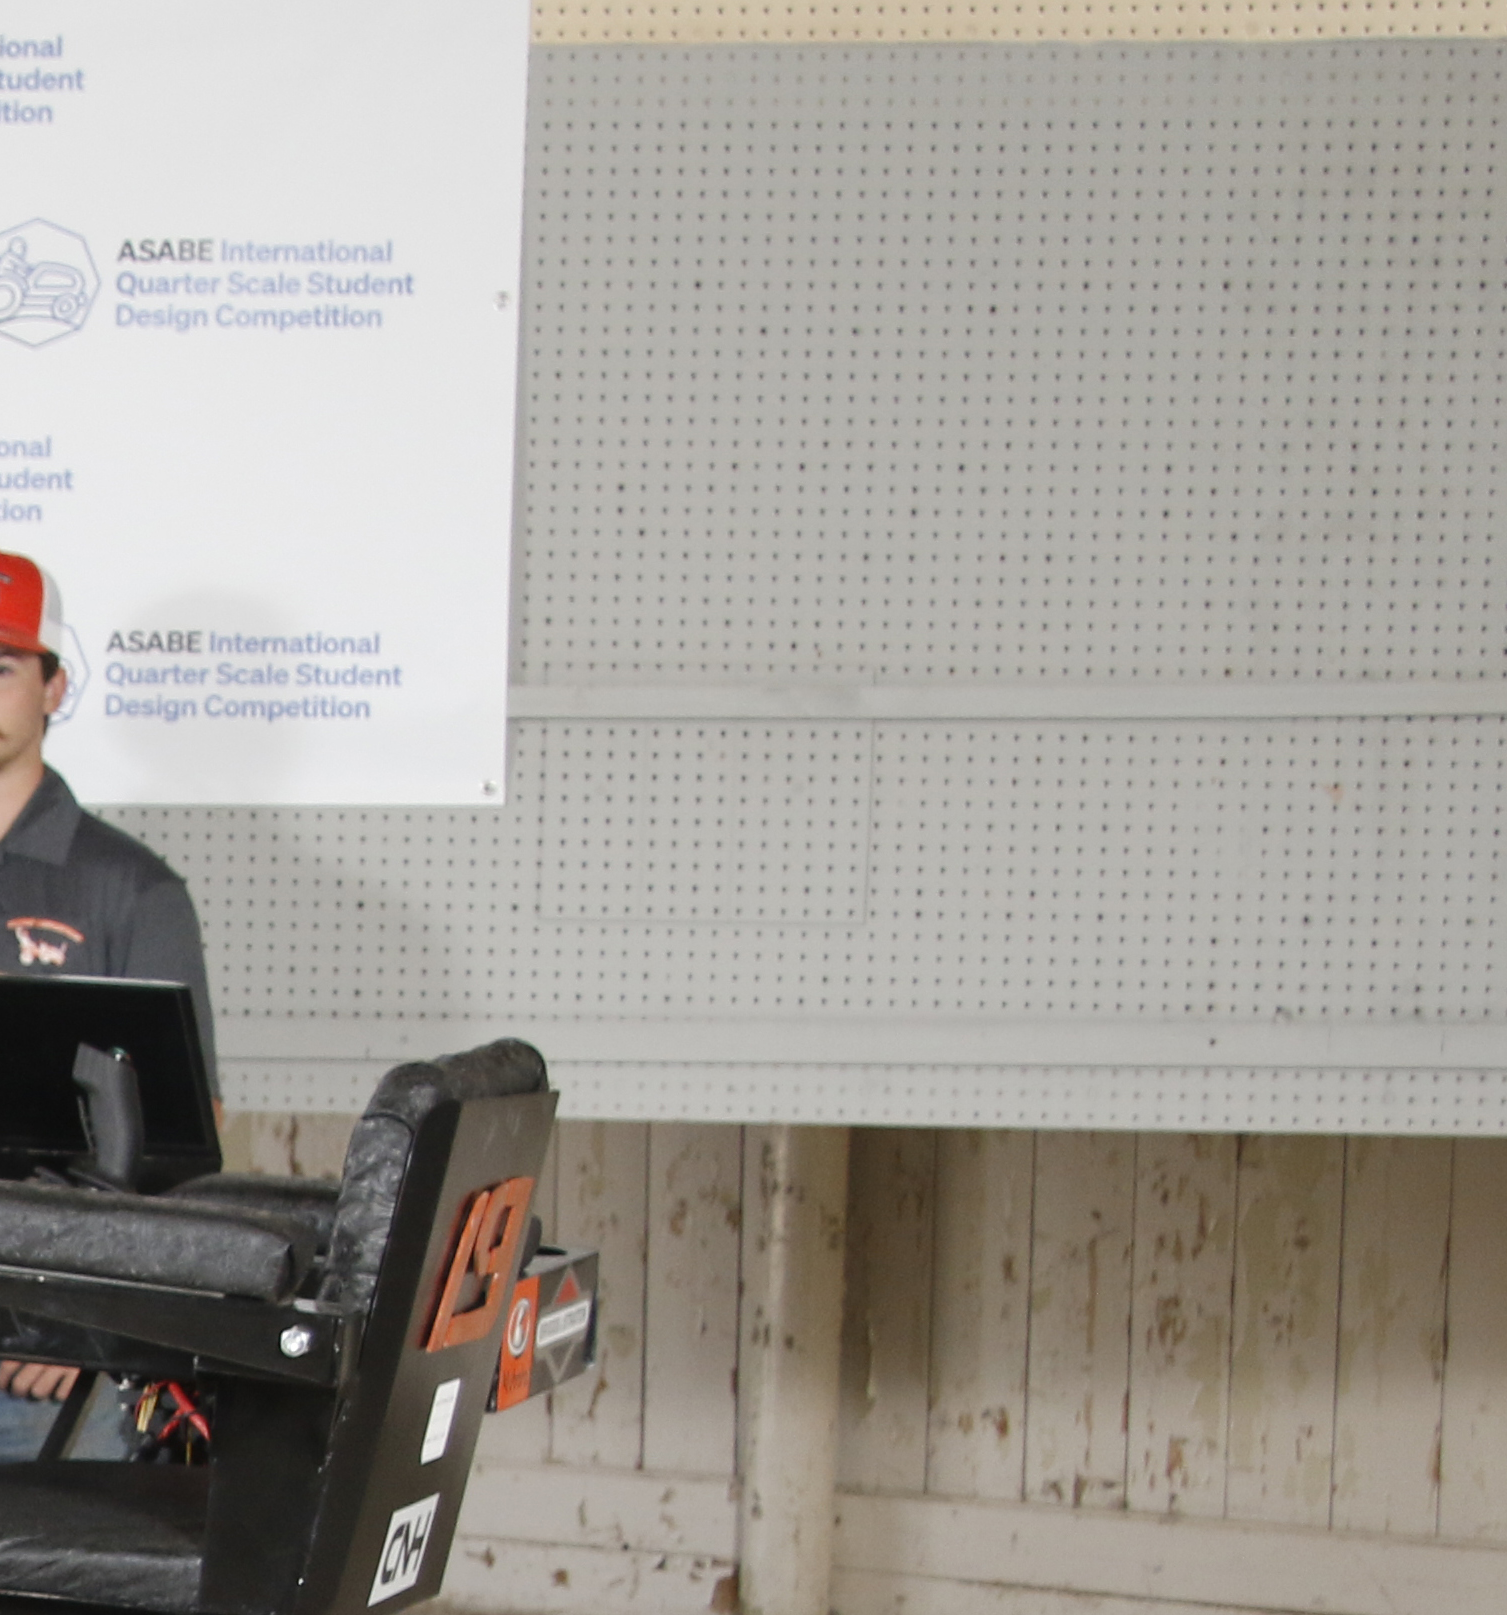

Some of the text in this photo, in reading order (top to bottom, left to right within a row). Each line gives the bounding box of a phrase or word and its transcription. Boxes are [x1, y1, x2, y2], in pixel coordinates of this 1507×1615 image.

[116, 238, 394, 263] ASABE International
[115, 271, 414, 297] Quarter Scale Student
[115, 303, 383, 331] Design Competition
[106, 629, 381, 654] ASABE International
[105, 661, 402, 687] Quarter Scale Student
[105, 694, 371, 723] Design Competition
[380, 1509, 432, 1586] CNH
